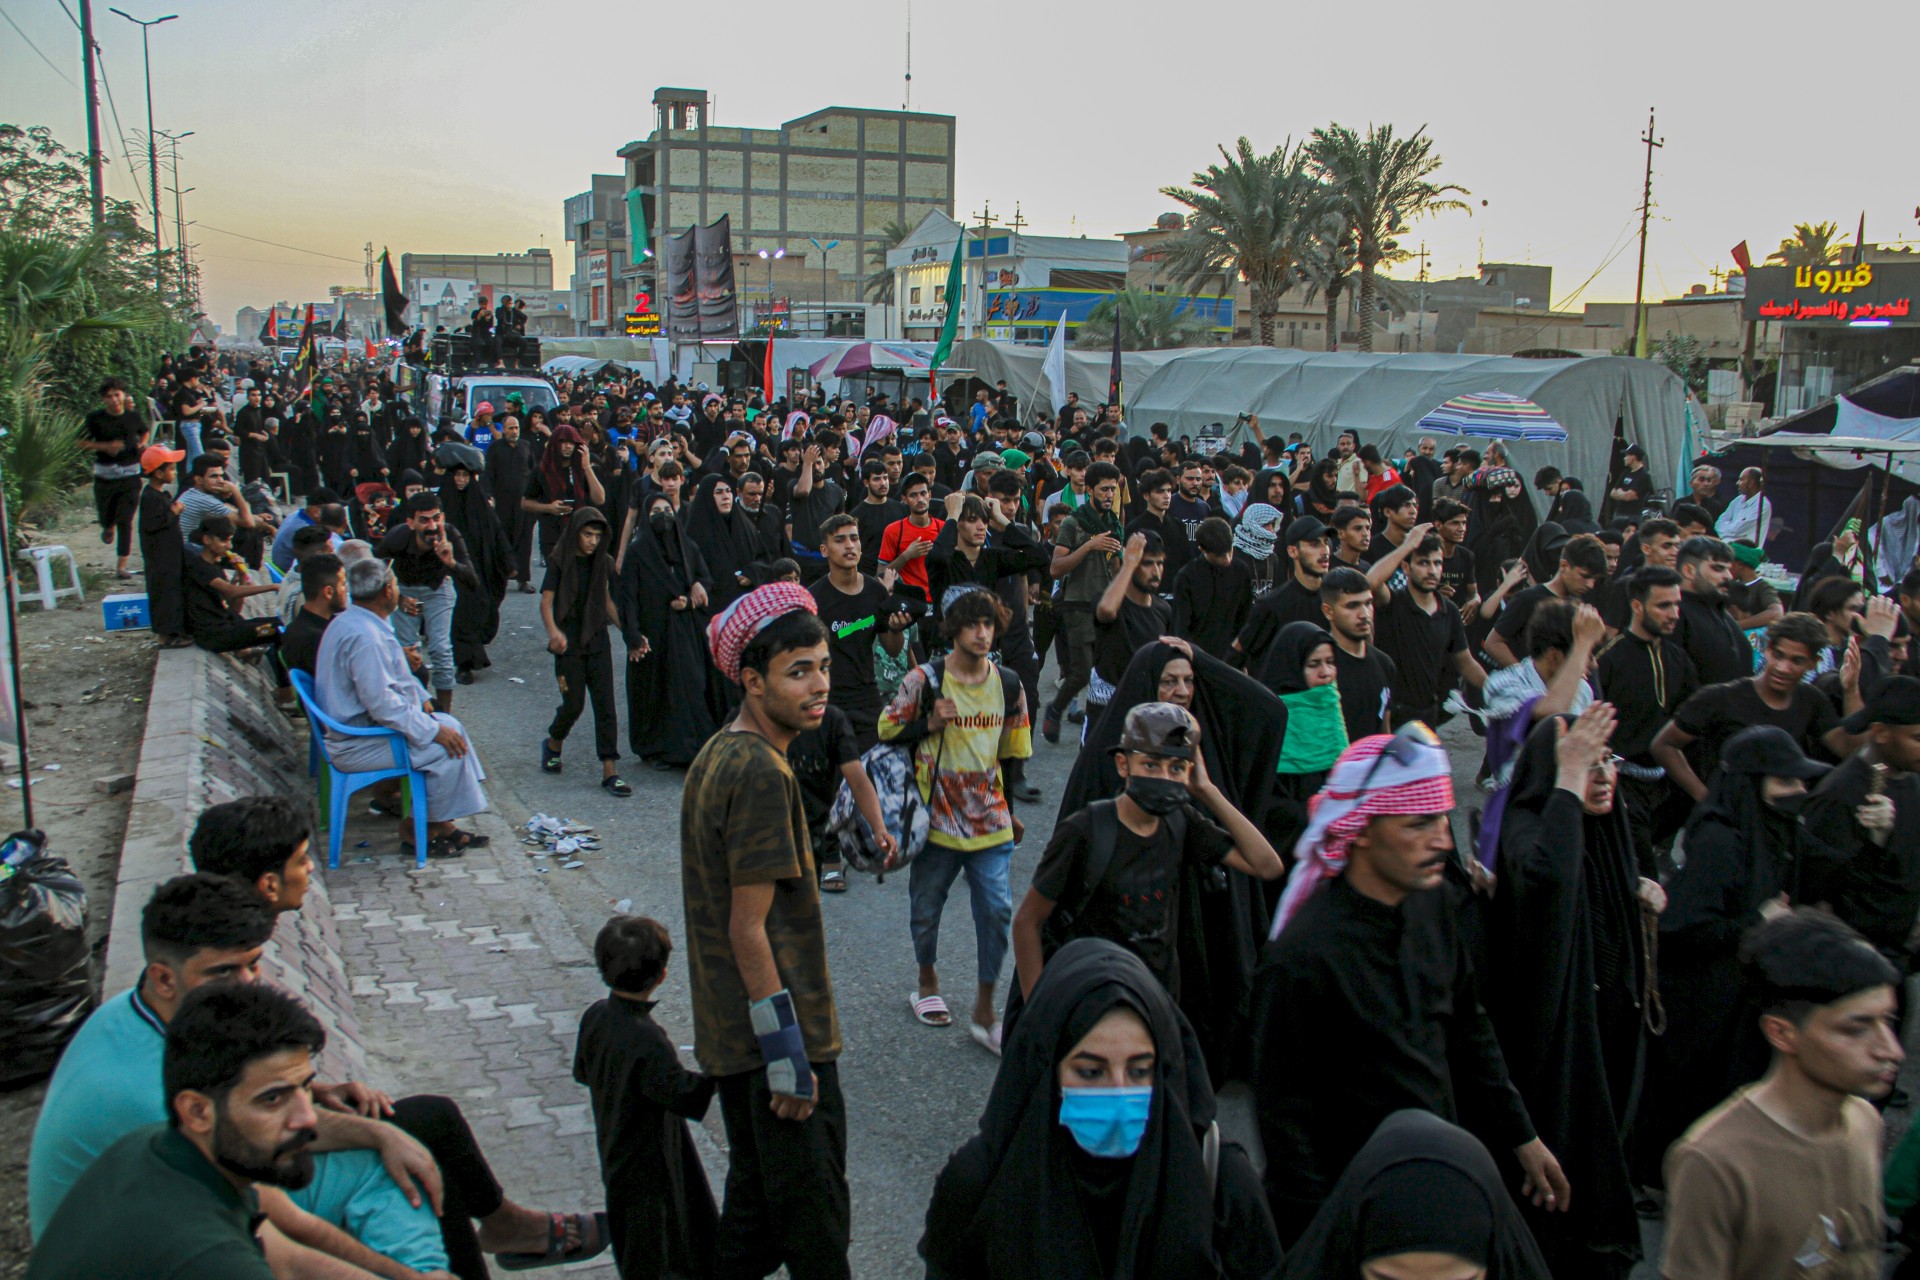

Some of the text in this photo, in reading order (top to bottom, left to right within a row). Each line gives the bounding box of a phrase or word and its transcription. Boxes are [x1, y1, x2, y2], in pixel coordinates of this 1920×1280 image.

[635, 293, 651, 313] 2
[1759, 298, 1910, 320] للمرمر والسيراميك
